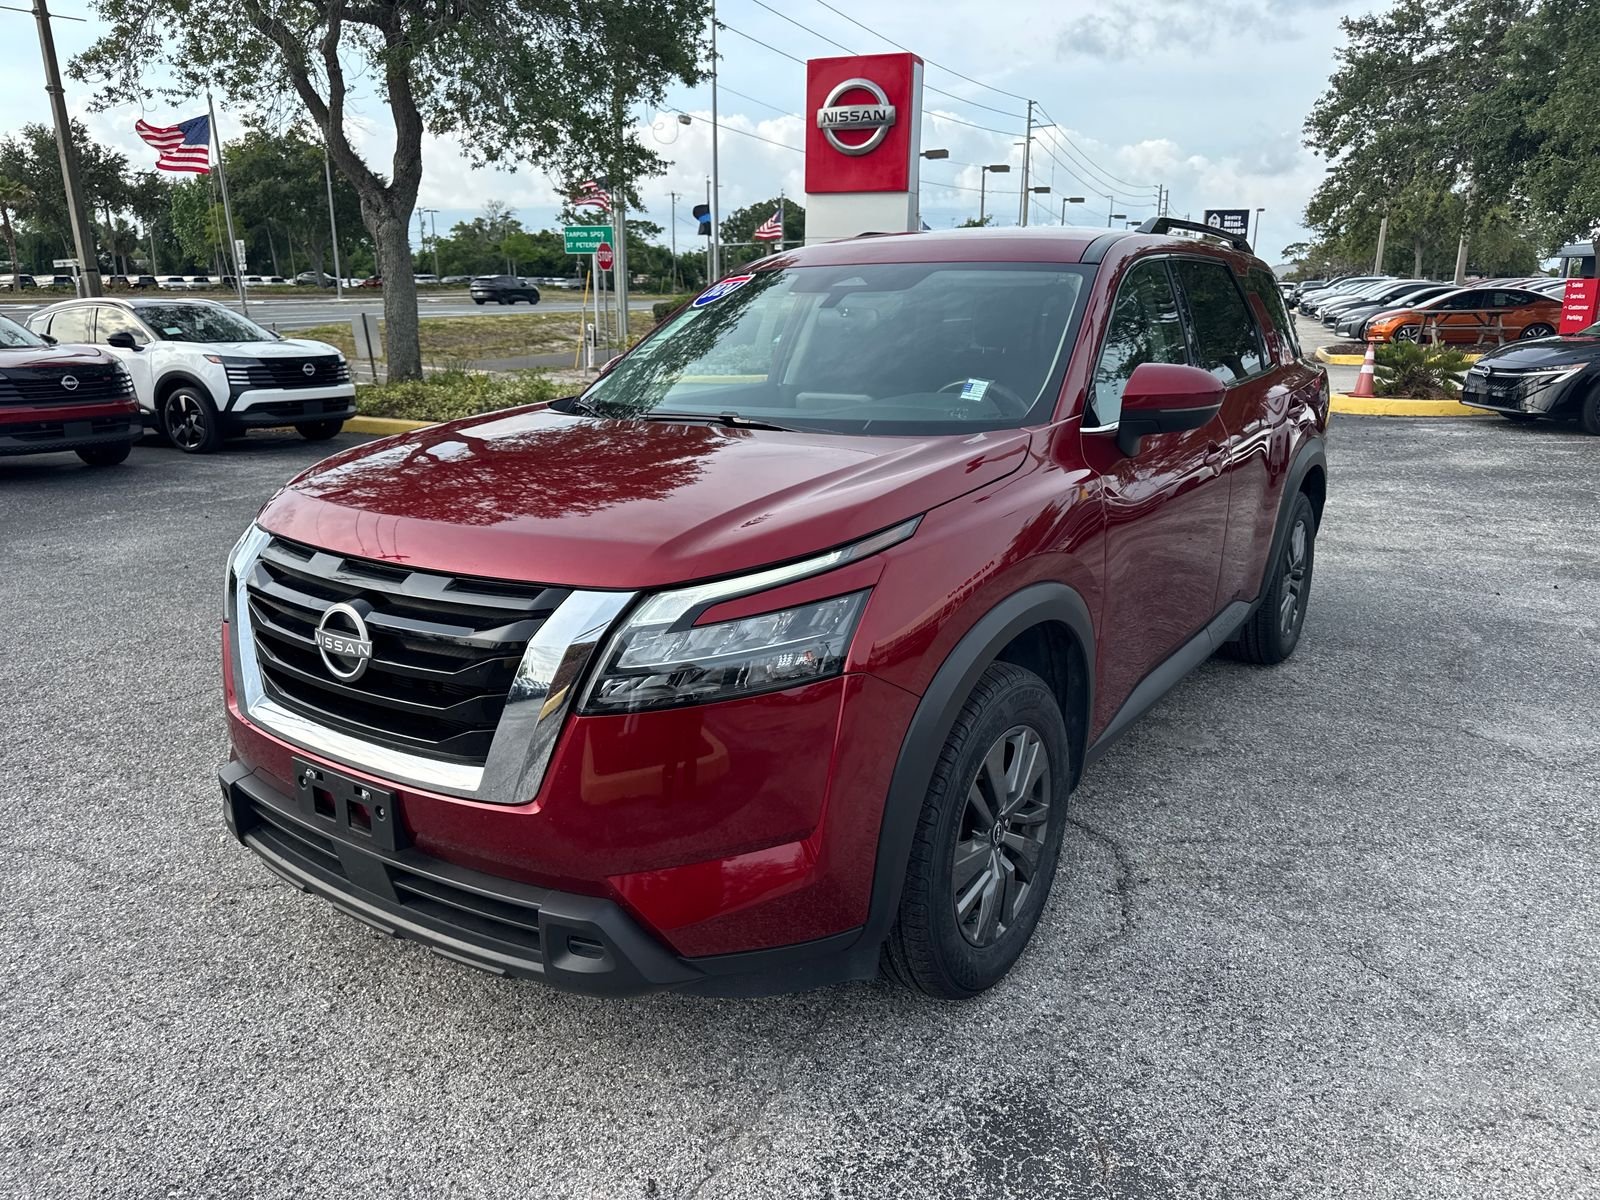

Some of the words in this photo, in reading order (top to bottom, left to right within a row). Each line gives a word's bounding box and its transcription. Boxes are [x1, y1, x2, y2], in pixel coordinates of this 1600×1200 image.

[823, 109, 886, 123] NISSAN
[598, 251, 612, 262] STOP
[315, 631, 370, 656] NISSAN
